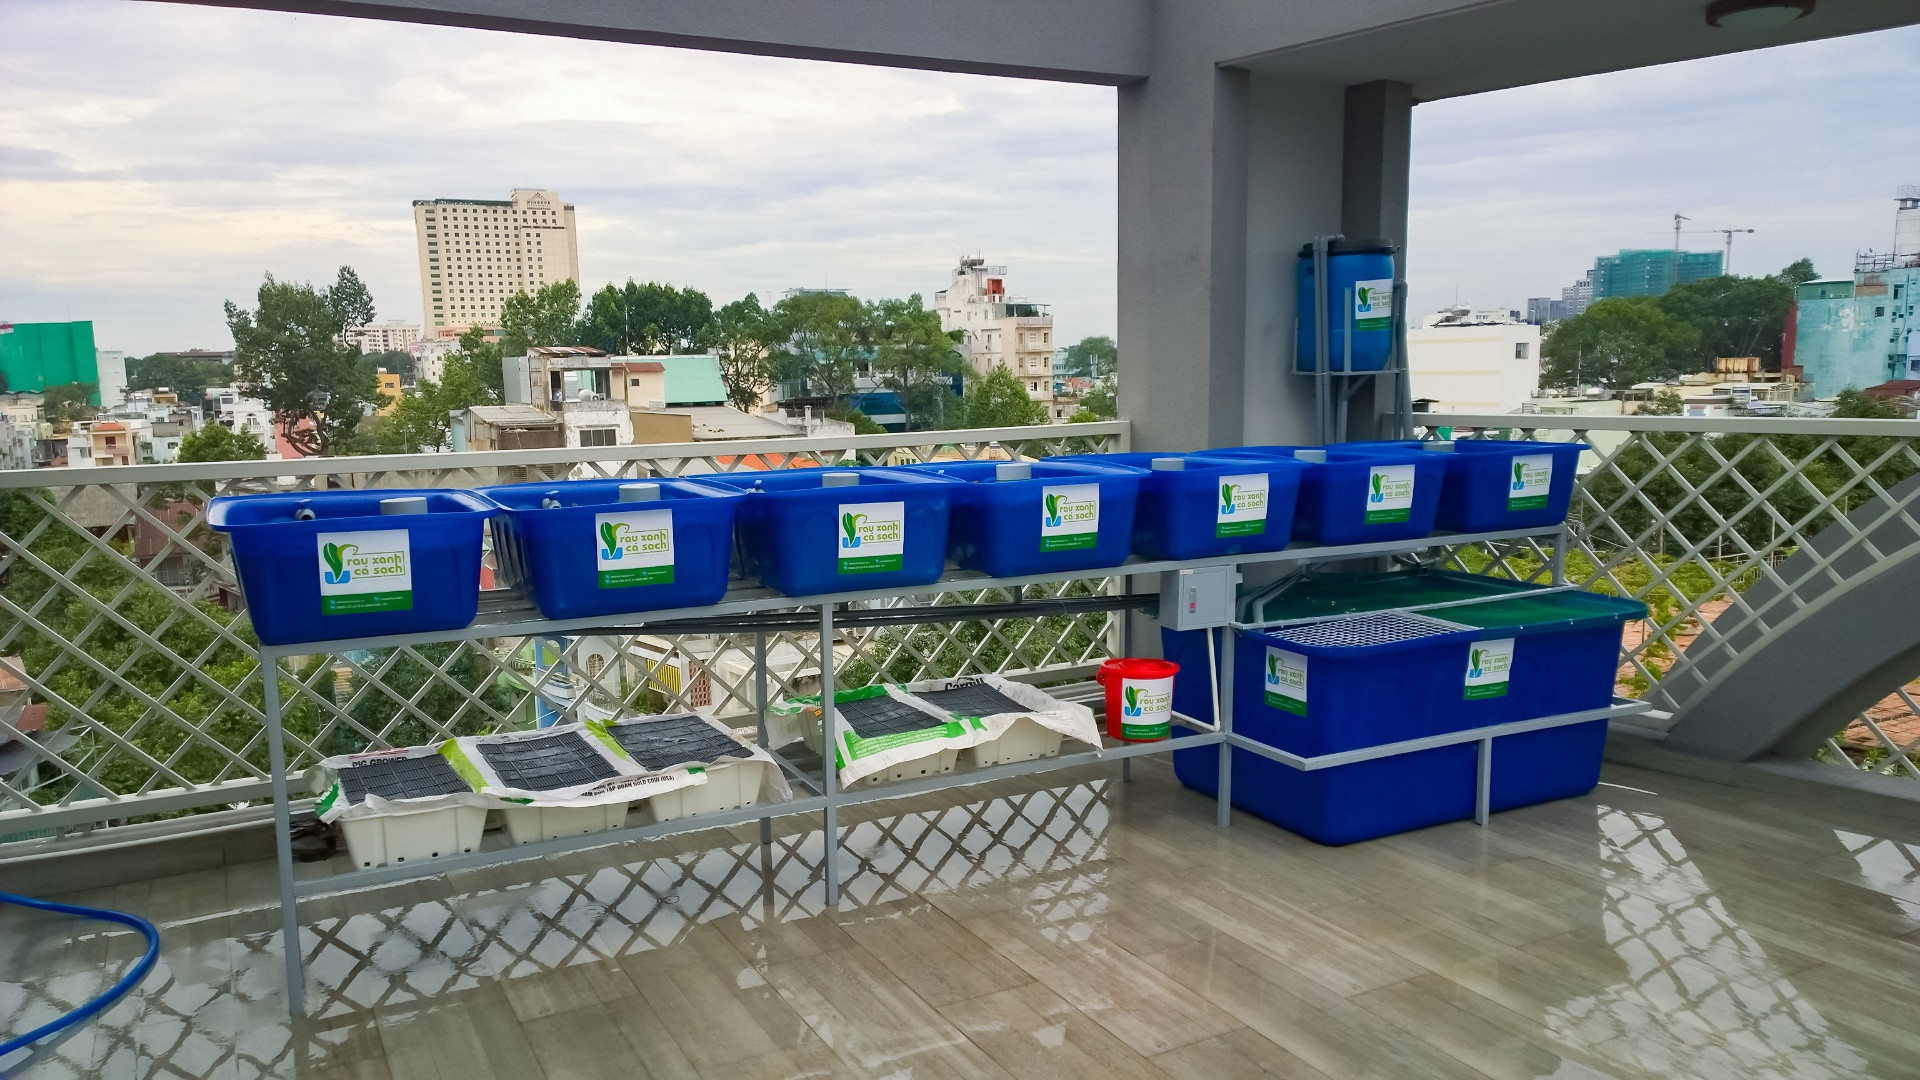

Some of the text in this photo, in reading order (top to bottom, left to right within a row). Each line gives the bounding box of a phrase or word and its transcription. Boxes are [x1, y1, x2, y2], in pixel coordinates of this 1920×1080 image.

[877, 523, 898, 531] xanh
[641, 531, 666, 541] xanh
[347, 554, 402, 566] rau xanh
